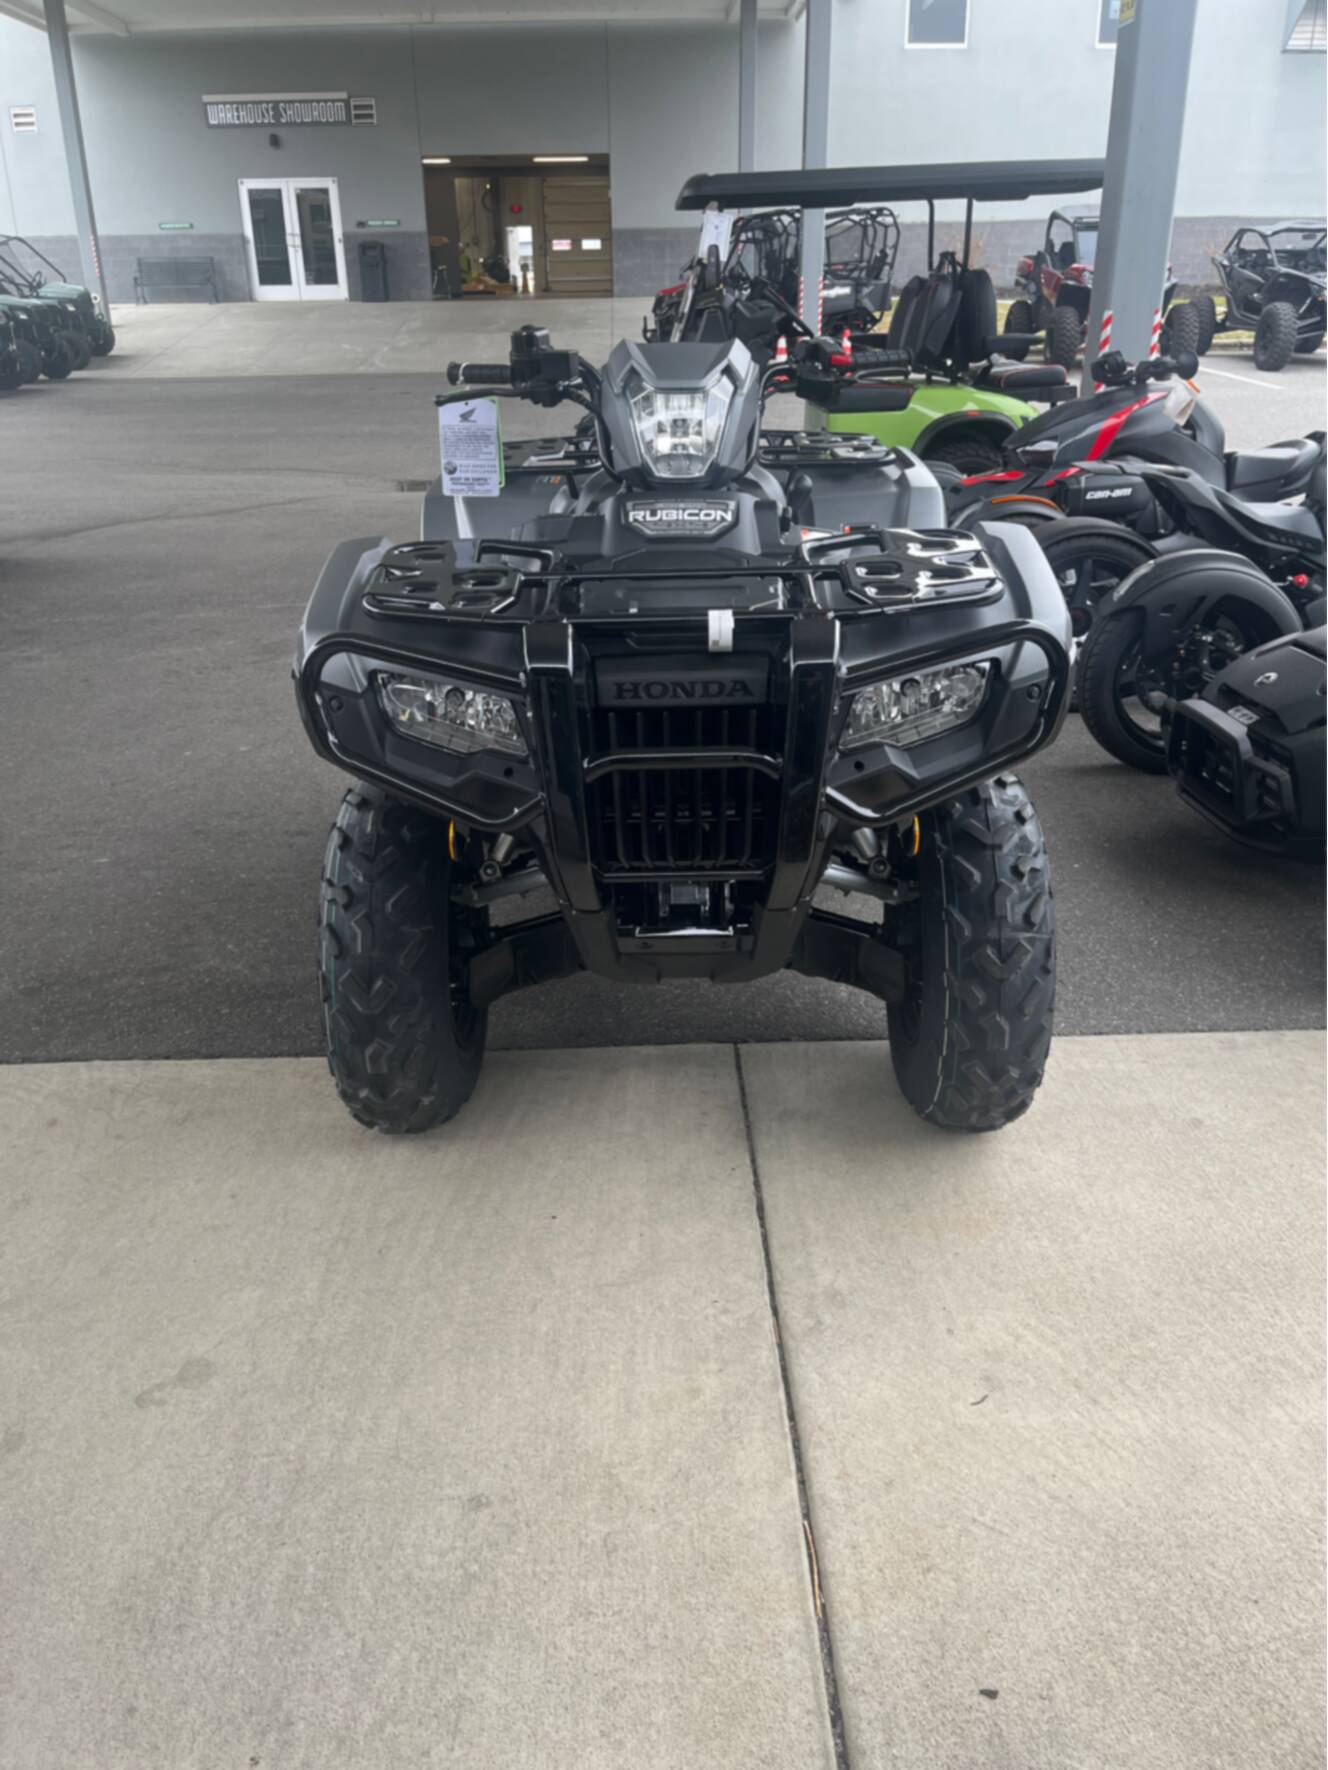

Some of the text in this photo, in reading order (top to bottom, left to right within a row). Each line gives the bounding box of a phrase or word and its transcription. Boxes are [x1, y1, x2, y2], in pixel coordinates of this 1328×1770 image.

[207, 102, 346, 125] WAREHOUSE SHOWROOM
[628, 509, 732, 522] RUBICON
[613, 679, 755, 700] HONDA
